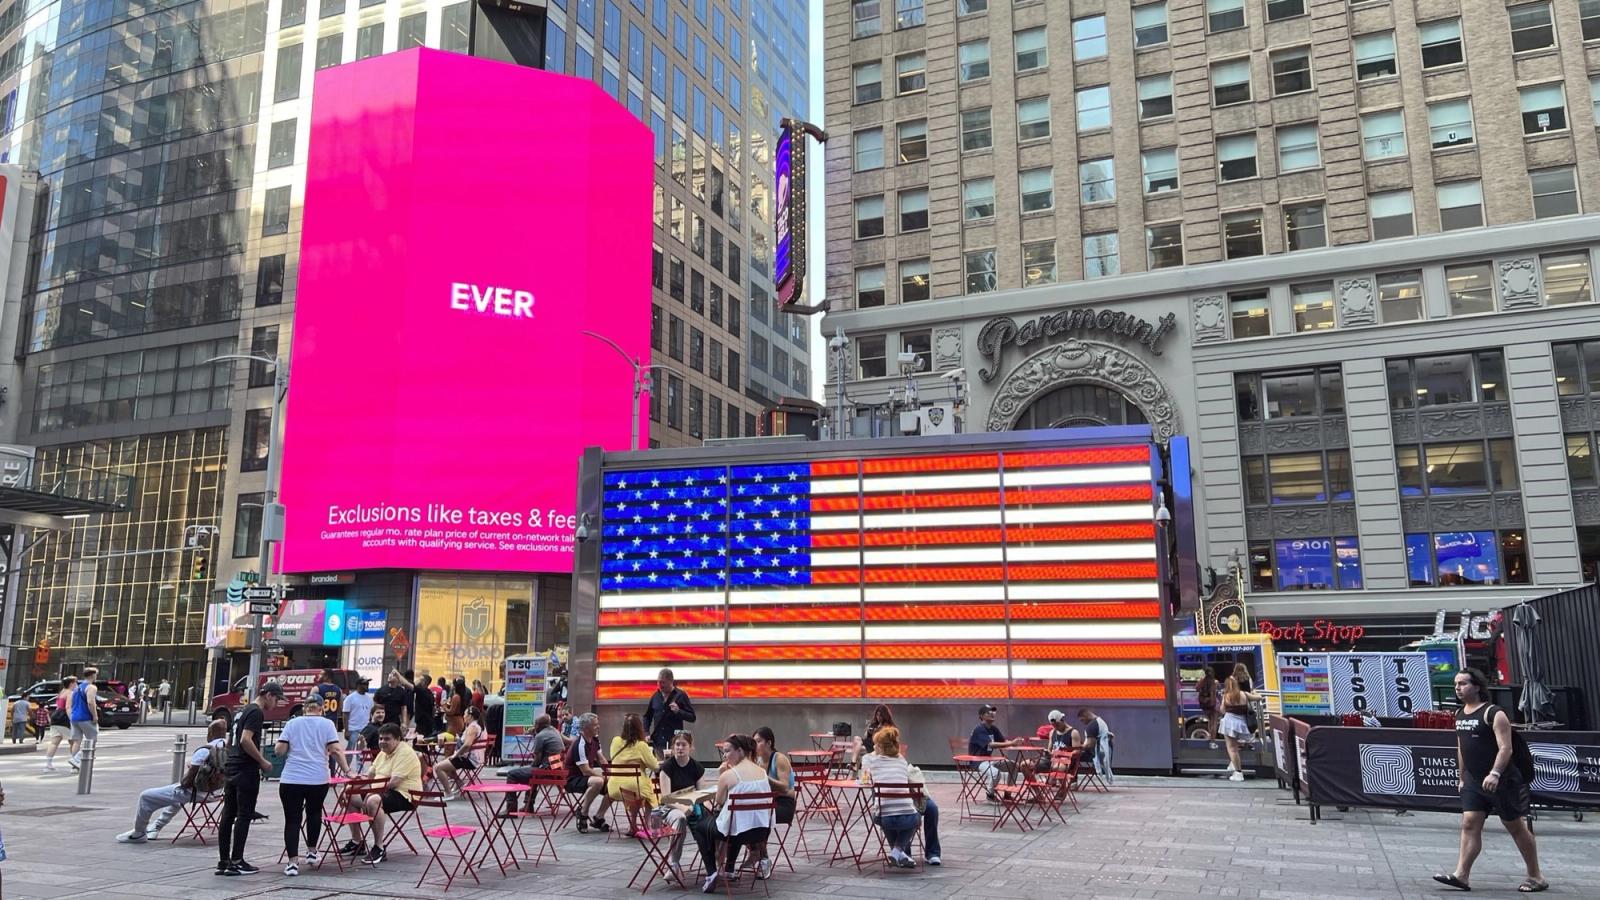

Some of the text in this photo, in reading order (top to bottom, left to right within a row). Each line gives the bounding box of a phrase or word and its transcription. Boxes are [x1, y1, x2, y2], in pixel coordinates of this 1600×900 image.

[450, 282, 535, 318] EVER
[977, 308, 1176, 383] Paramount
[328, 502, 421, 525] Exclusions
[427, 504, 462, 524] like
[468, 507, 522, 527] taxes
[528, 508, 542, 528] &
[320, 530, 359, 540] Guarantees
[360, 528, 385, 538] regular
[386, 528, 402, 536] mo.
[404, 528, 422, 537] rate
[424, 528, 443, 538] plan
[445, 529, 467, 540] price
[468, 530, 478, 539] of
[480, 531, 510, 540] current
[512, 533, 559, 542] on-network
[362, 537, 396, 547] accounts
[398, 538, 417, 547] with
[418, 539, 462, 551] qualifying
[464, 540, 497, 550] service.
[499, 541, 515, 550] See
[516, 542, 558, 552] exclusions
[311, 574, 338, 583] branded
[1258, 619, 1307, 643] Rock
[1313, 618, 1364, 643] Shop
[358, 656, 384, 666] OURO
[511, 660, 531, 669] TSQ
[1284, 656, 1310, 667] TSQ
[1393, 659, 1413, 713] TSQ
[324, 699, 338, 712] 30
[1421, 757, 1457, 767] TIMES
[1418, 768, 1460, 778] SQUARE
